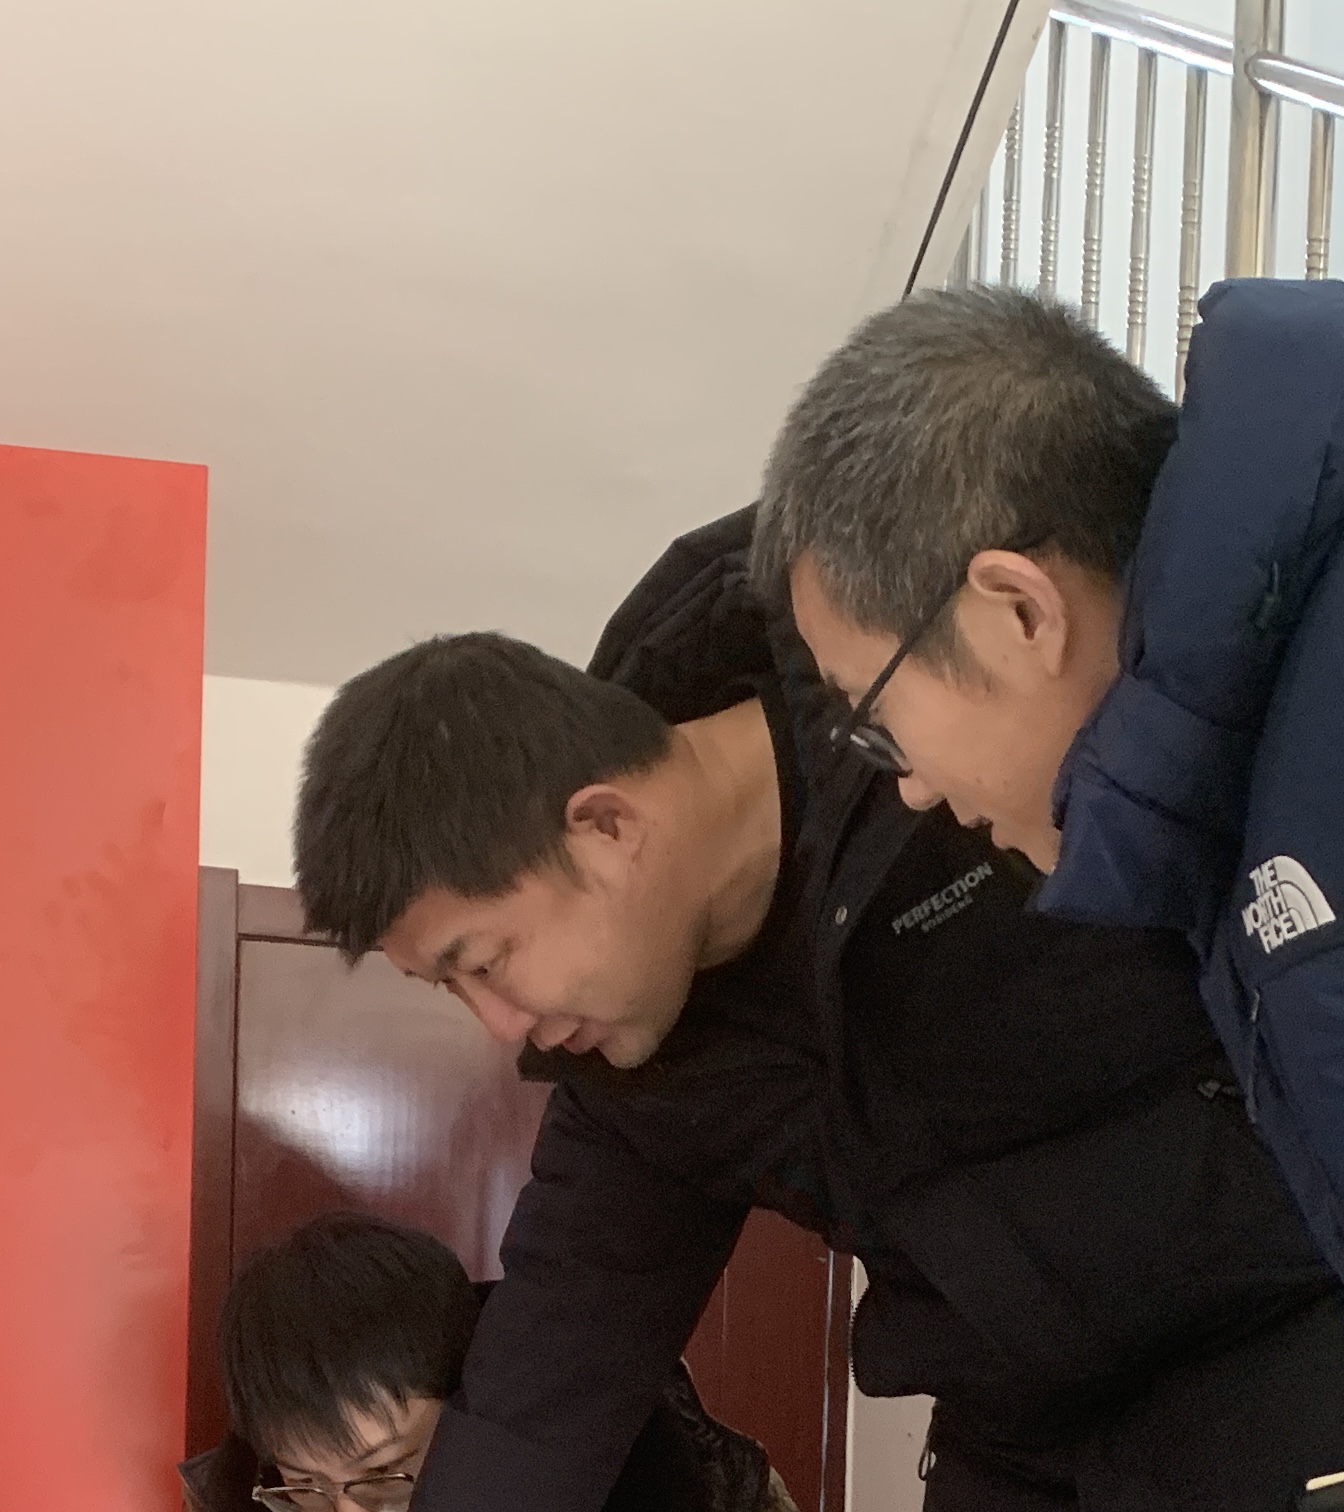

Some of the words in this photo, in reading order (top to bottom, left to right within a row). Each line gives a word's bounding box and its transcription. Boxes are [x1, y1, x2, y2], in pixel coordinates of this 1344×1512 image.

[893, 863, 993, 934] PERFECTION
[1249, 859, 1278, 897] THE
[1242, 884, 1288, 937] NORTH
[1259, 912, 1299, 955] FACE
